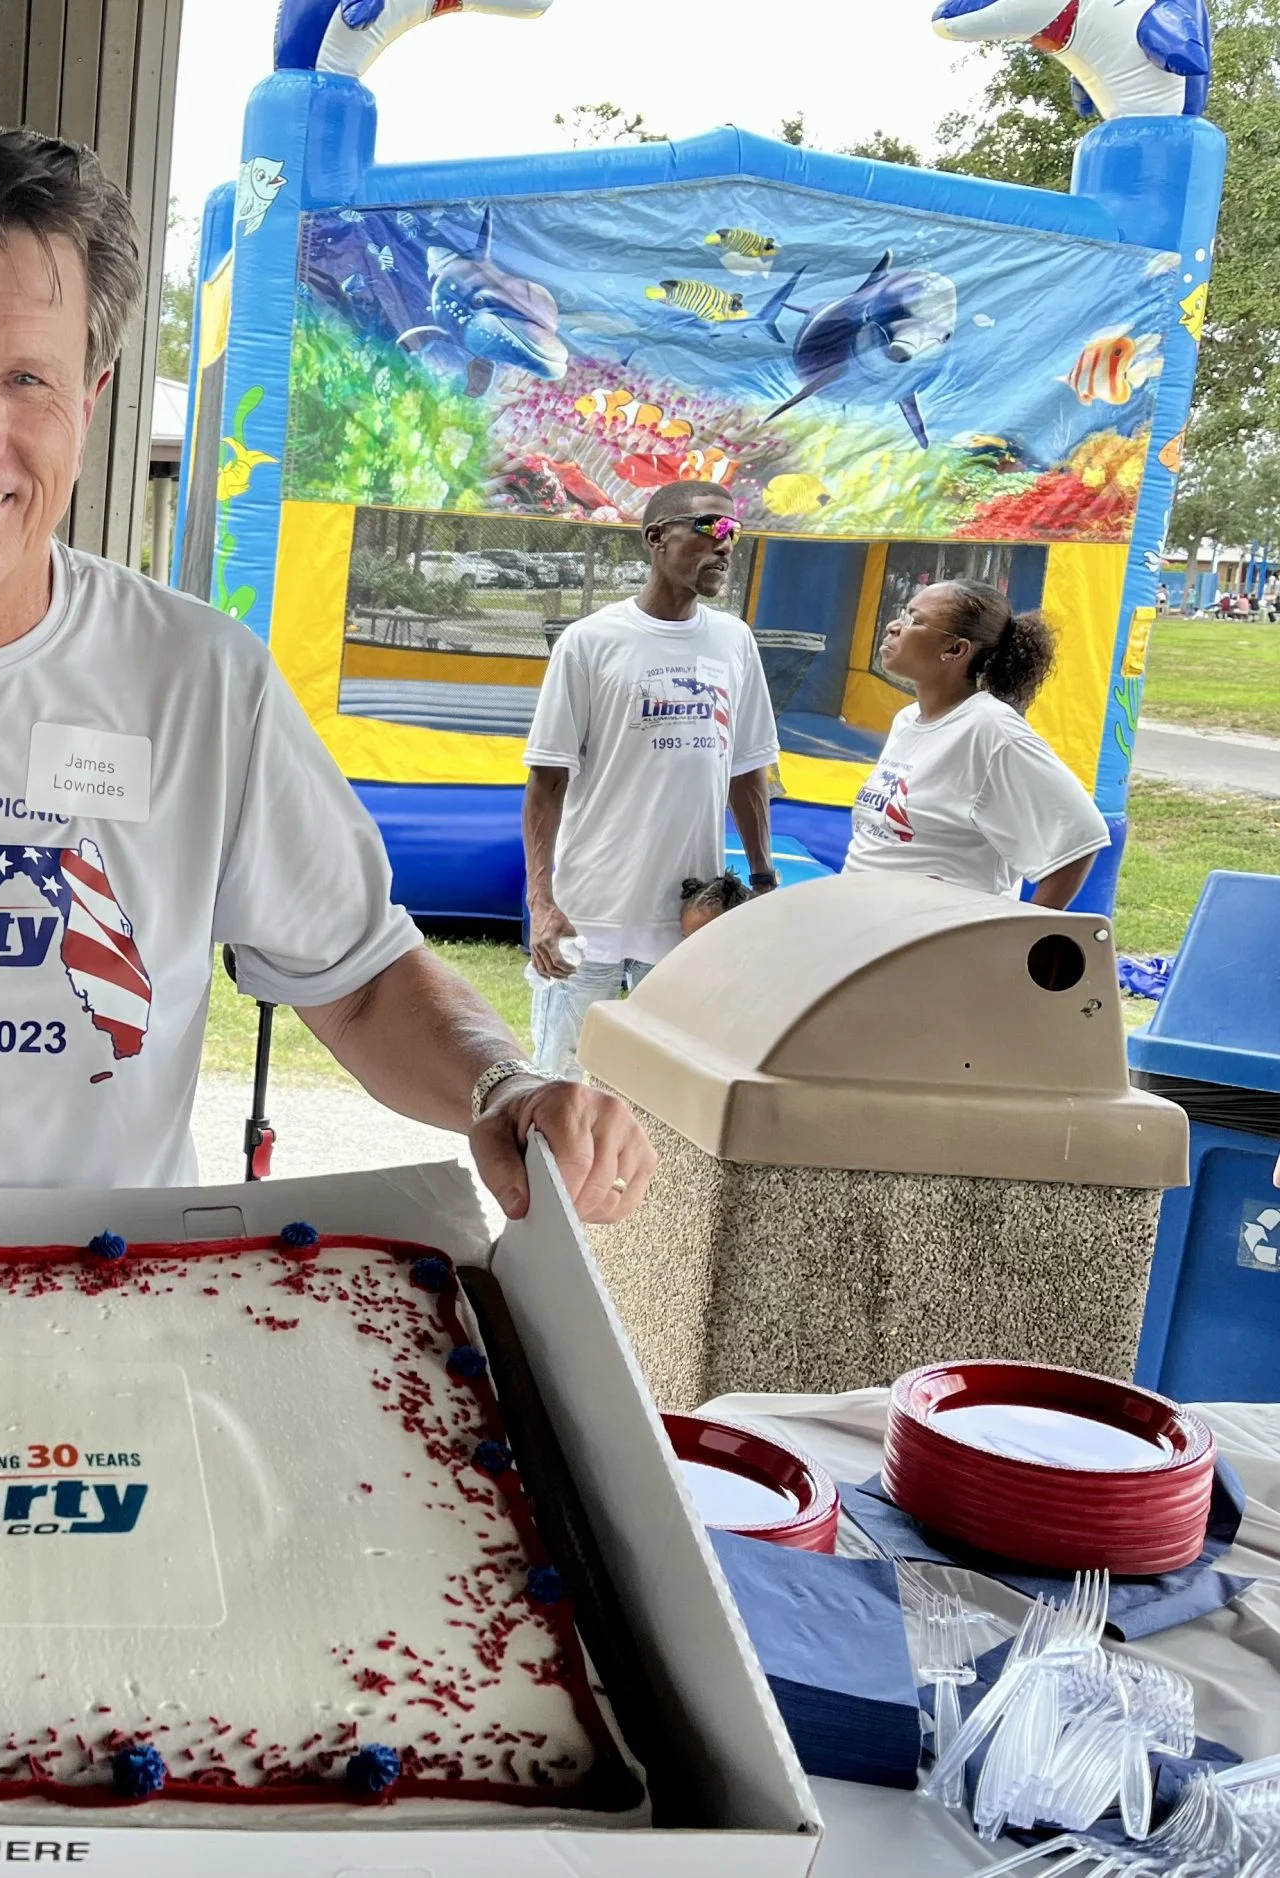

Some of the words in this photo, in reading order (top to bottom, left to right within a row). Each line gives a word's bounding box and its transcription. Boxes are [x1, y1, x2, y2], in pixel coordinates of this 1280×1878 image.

[665, 666, 691, 674] FAMILY
[642, 699, 713, 720] Liberty
[651, 738, 682, 749] 1993
[693, 737, 716, 748] 2023
[65, 752, 115, 774] James
[53, 774, 125, 798] Lowndes
[26, 1444, 79, 1468] 30
[85, 1453, 142, 1468] YEARS
[7, 1523, 68, 1536] CO.
